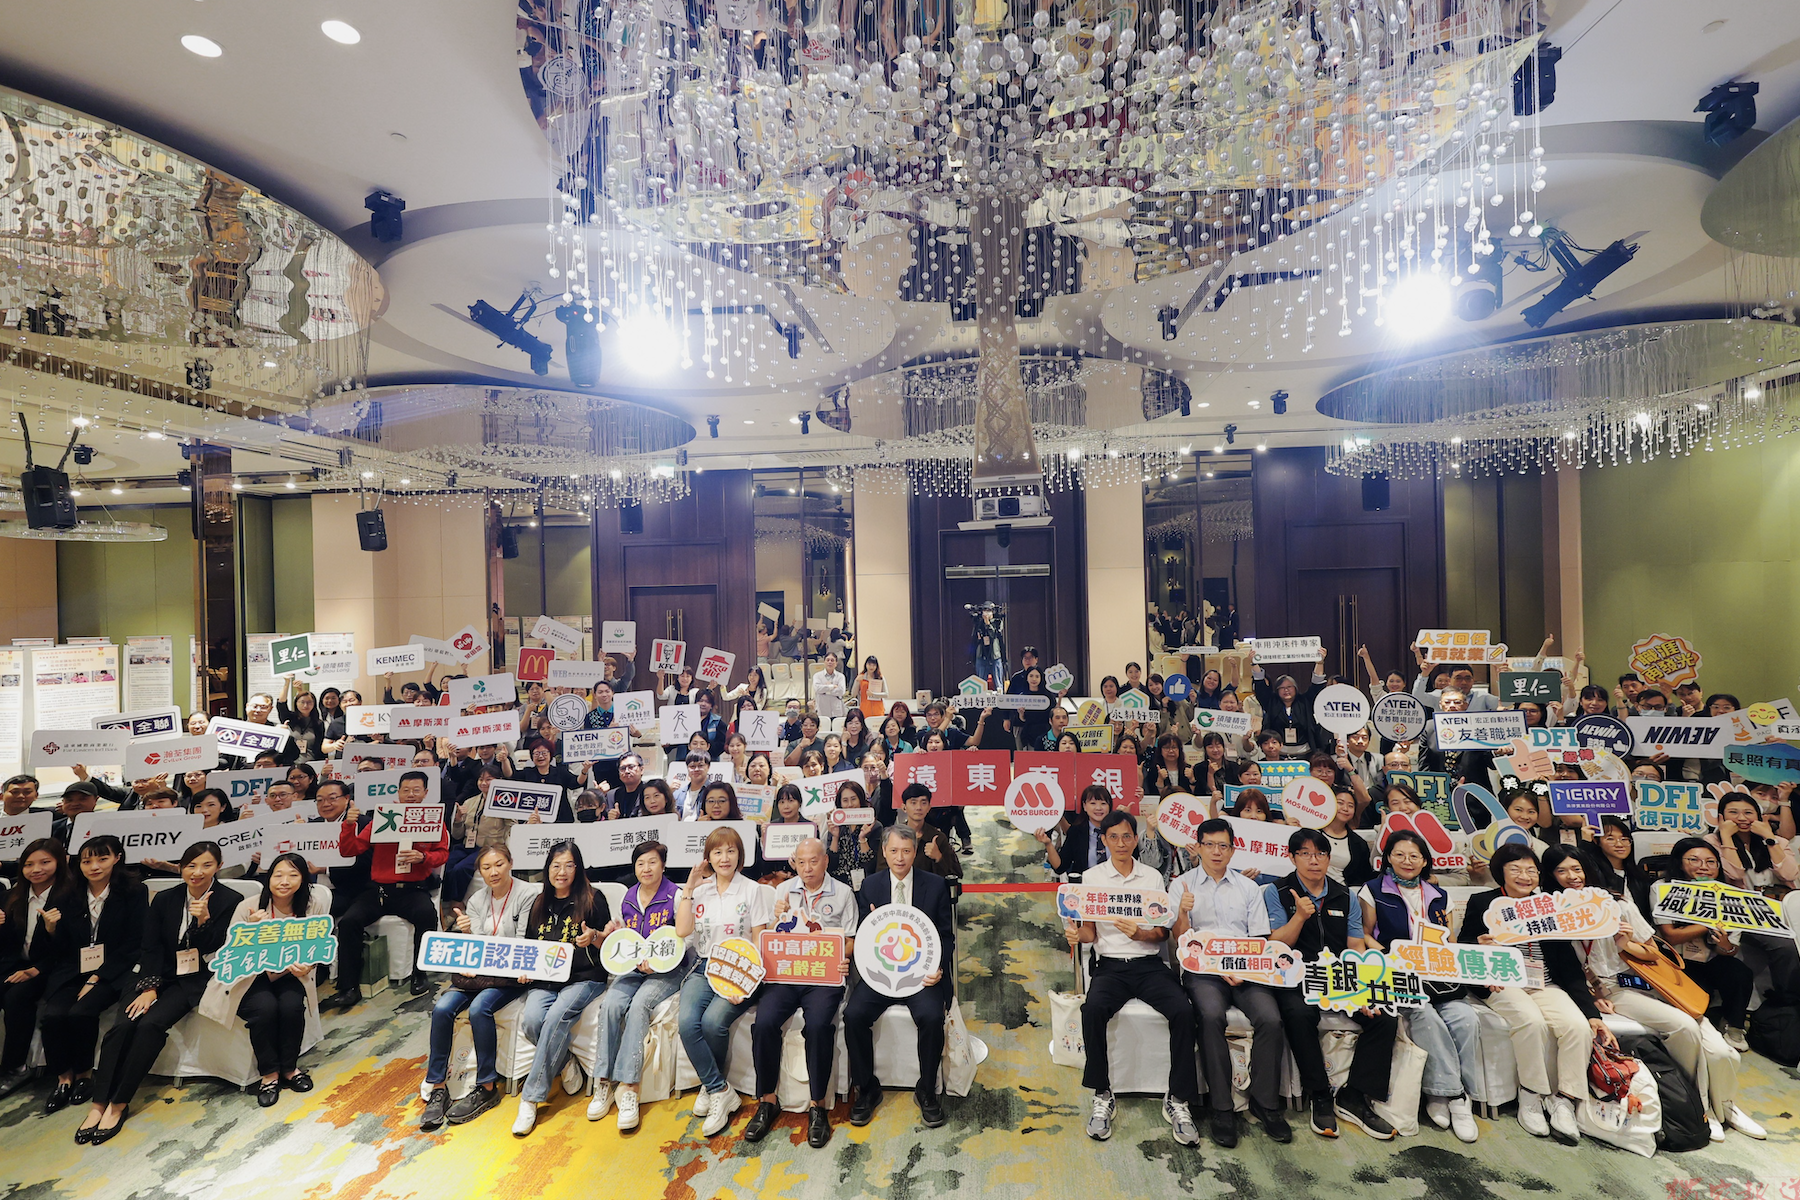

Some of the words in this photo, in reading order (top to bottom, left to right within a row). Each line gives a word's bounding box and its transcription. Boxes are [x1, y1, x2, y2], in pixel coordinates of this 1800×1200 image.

[1419, 632, 1487, 646] 人才回任
[276, 646, 307, 666] 里仁
[375, 653, 416, 665] KENMEC
[1431, 647, 1485, 661] 再就業
[1634, 639, 1680, 667] 職涯
[658, 662, 676, 670] KFC
[702, 659, 729, 673] Pizza
[702, 668, 721, 679] Hut
[1642, 652, 1697, 682] 再發光
[552, 670, 568, 678] WEB
[1510, 677, 1551, 697] 里仁
[1323, 702, 1361, 712] ATEN
[1384, 700, 1416, 709] ATEN
[136, 716, 170, 732] 全聯
[1376, 716, 1423, 724] 友善職場認證
[1441, 717, 1468, 725] ATEN
[1474, 716, 1520, 724] 宏正自動科技
[472, 722, 512, 736] 摩斯漢堡
[244, 734, 276, 749] 全聯
[572, 732, 598, 742] ATEN
[1531, 729, 1578, 747] DFI
[184, 754, 202, 762] Group
[230, 778, 273, 798] DFI
[368, 784, 398, 797] EZC
[1296, 785, 1304, 800] I
[1391, 774, 1448, 798] DFI
[522, 795, 550, 809] 全聯
[1556, 788, 1620, 801] MERRY
[1640, 783, 1699, 810] DFI
[405, 808, 442, 823] 愛買
[1168, 801, 1186, 819] 我
[1285, 798, 1302, 810] MOS
[1301, 804, 1328, 821] BURGER
[1639, 810, 1701, 829] 很可以
[398, 824, 441, 834] a.mart
[217, 828, 264, 847] CREA
[610, 829, 660, 846] 三商家購
[296, 840, 341, 851] LITEMAX
[610, 843, 630, 852] Simple
[526, 850, 546, 858] Simple
[1086, 892, 1142, 904] 年齡不是界線
[696, 904, 704, 918] 9
[1084, 904, 1143, 917] 經驗就是價值
[1500, 894, 1557, 922] 讓經驗
[1657, 885, 1789, 930] 職場無限
[723, 924, 735, 934] 石
[1526, 908, 1596, 936] 持續發光
[231, 919, 329, 948] 友善無齡
[428, 938, 539, 972] 新北認證
[609, 939, 676, 960] 人才永續
[768, 938, 835, 958] 中高齡及
[1210, 940, 1262, 955] 年齡不同
[216, 941, 334, 981] 青銀同行
[711, 945, 764, 981] 認證肯定
[1220, 956, 1273, 971] 價值相同
[1398, 943, 1522, 981] 經驗傳承
[776, 960, 827, 978] 高齡者
[707, 962, 757, 993] 企業榮耀
[1304, 960, 1423, 1010] 青銀共融
